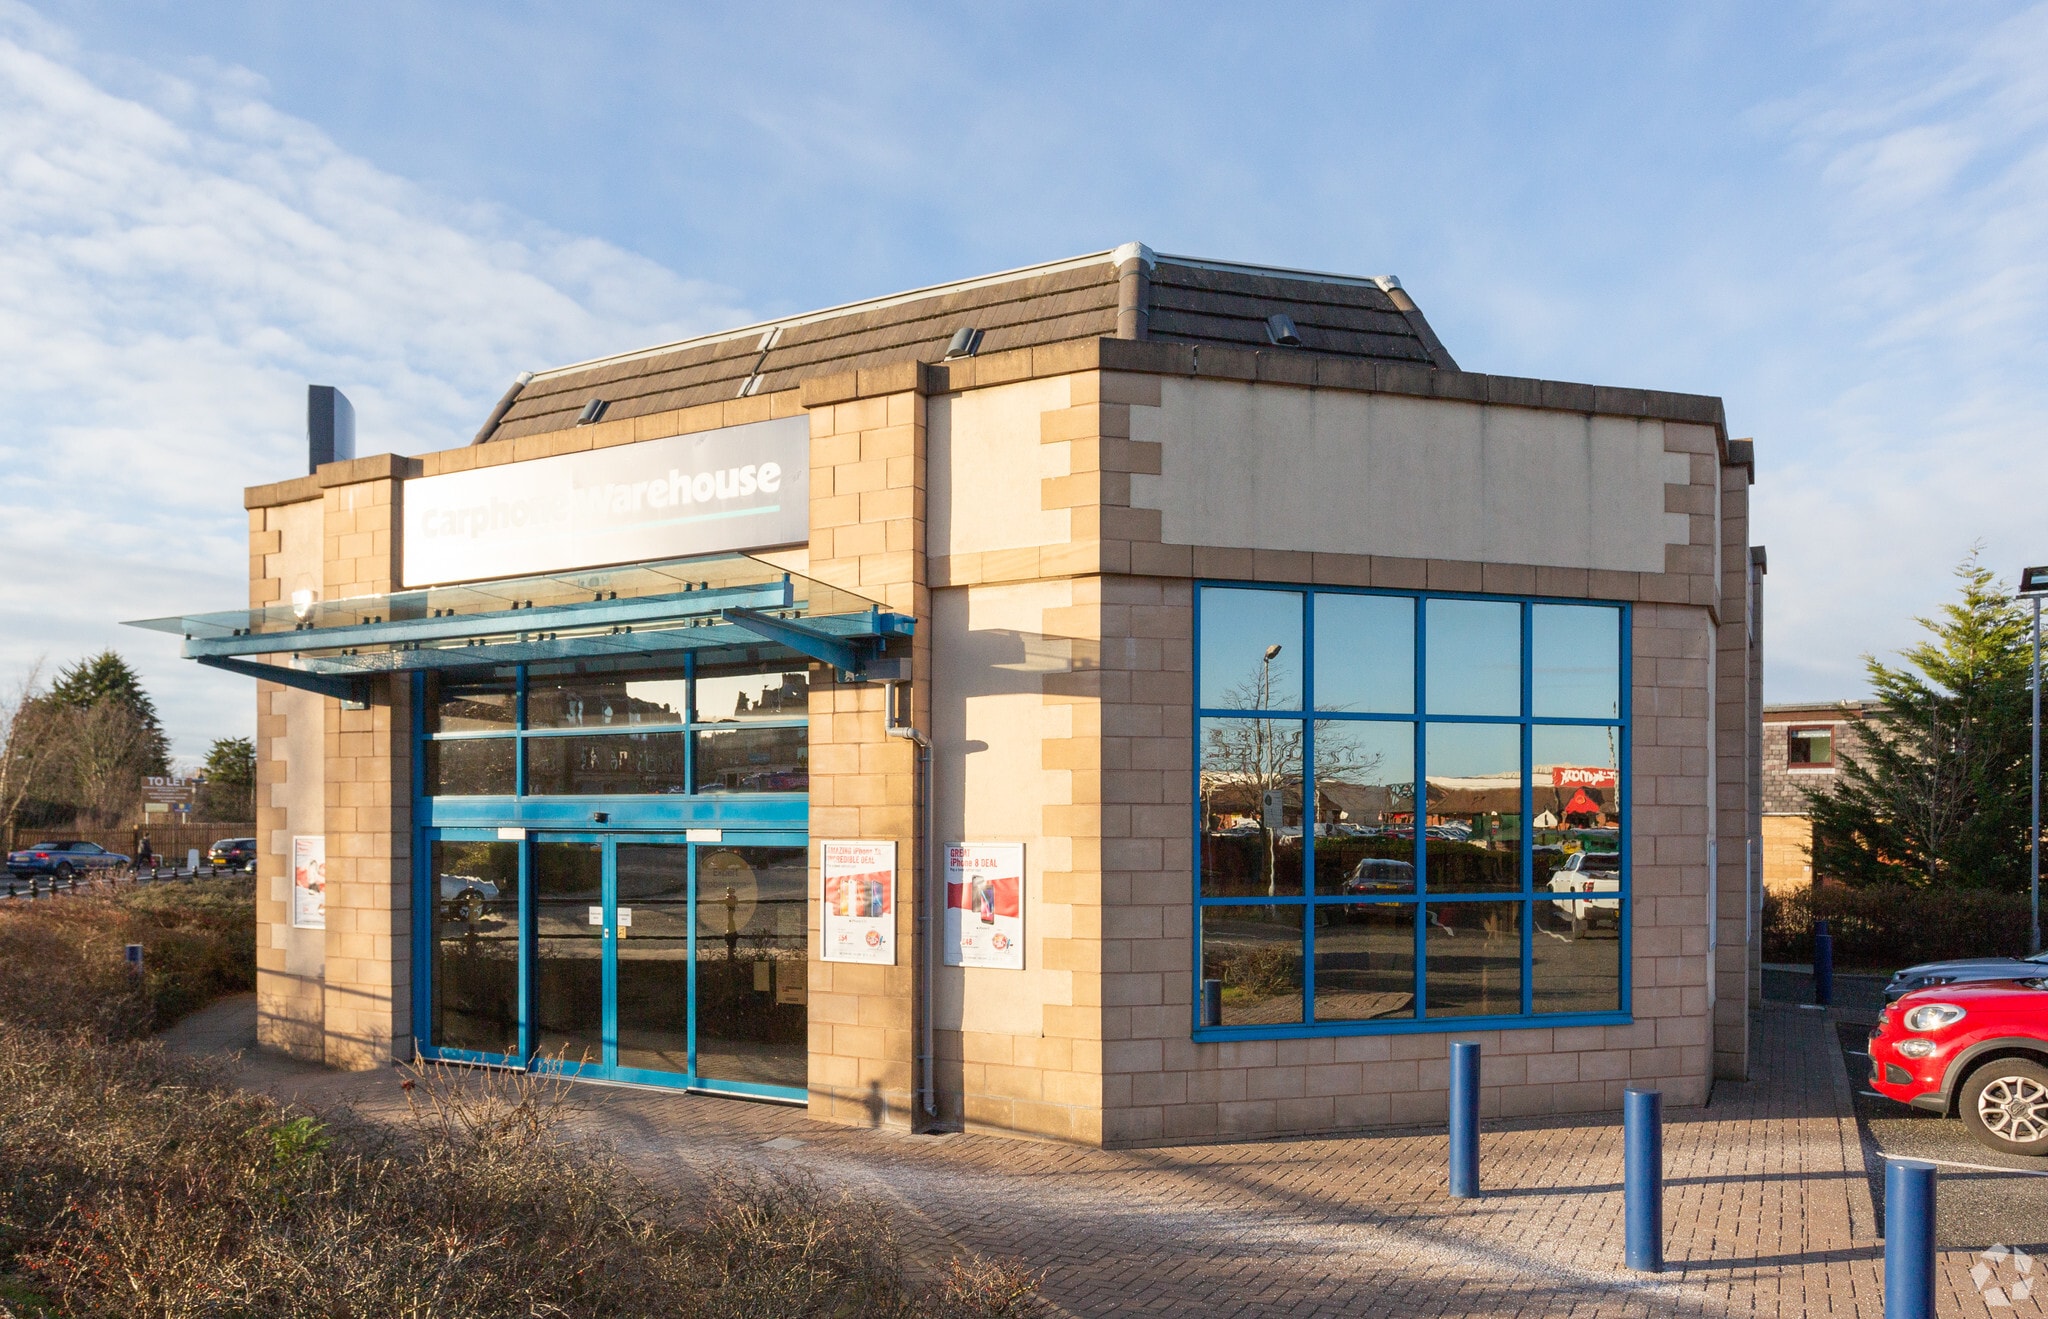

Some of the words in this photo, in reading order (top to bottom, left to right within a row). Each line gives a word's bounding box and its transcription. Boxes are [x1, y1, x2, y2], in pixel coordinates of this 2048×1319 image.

[421, 494, 568, 539] carphone
[147, 776, 164, 786] TO
[166, 776, 186, 786] LET
[853, 847, 873, 856] iPhone
[950, 848, 970, 858] GREAT
[828, 855, 860, 864] INCREDIBLE
[861, 856, 875, 865] DEAL
[950, 858, 972, 868] iPhone
[974, 858, 979, 868] 8
[981, 858, 998, 868] DEAL
[713, 868, 738, 877] Expert
